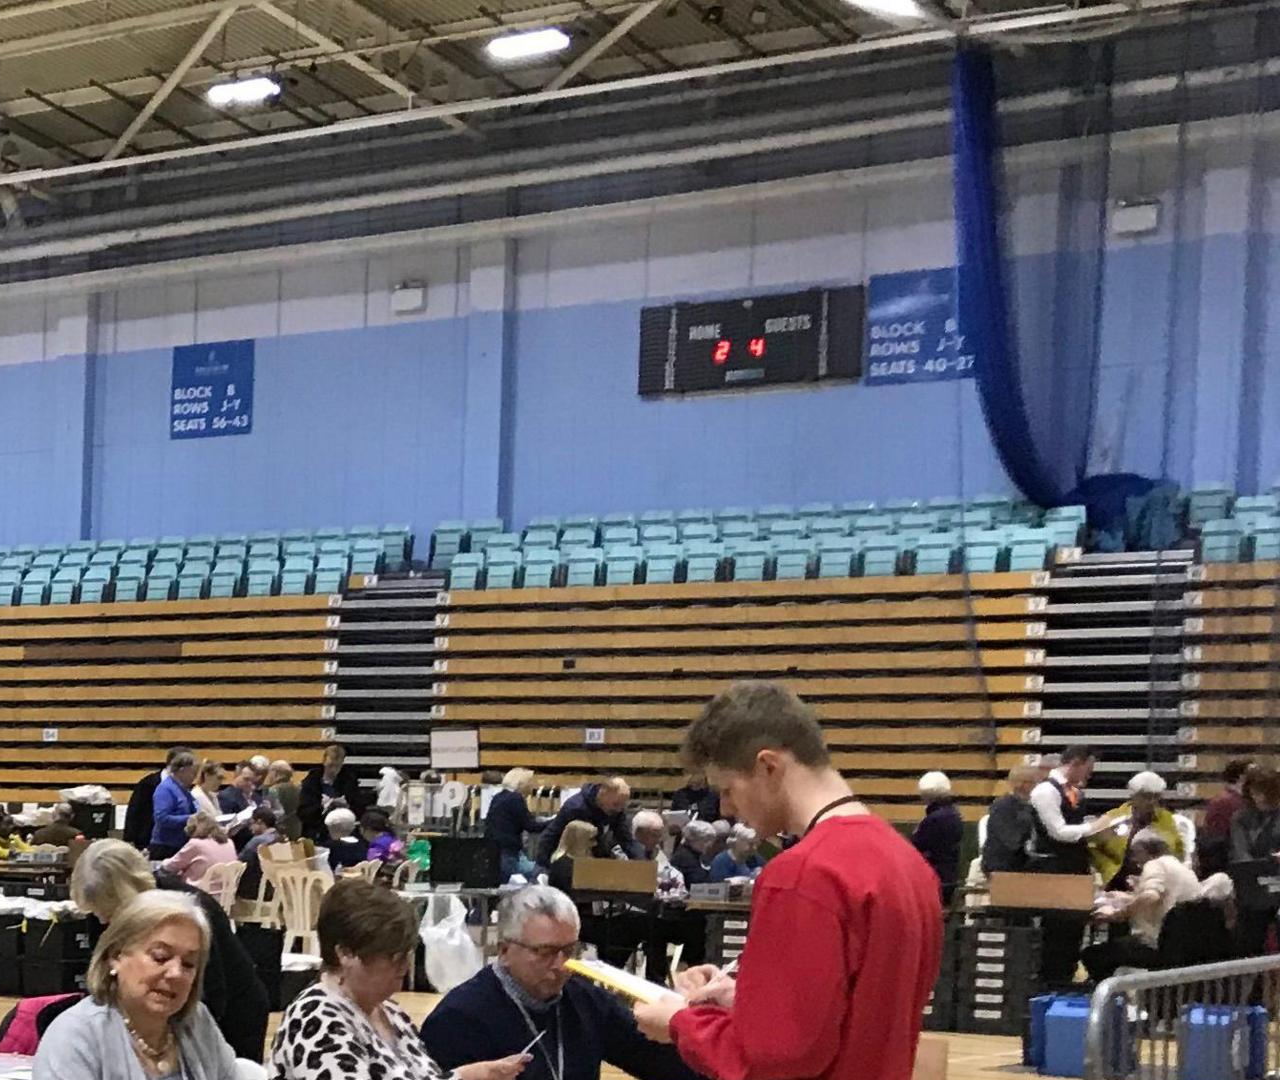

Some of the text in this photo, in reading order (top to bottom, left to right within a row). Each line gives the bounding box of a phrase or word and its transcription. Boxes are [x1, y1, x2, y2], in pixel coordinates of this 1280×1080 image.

[689, 323, 721, 340] HOME
[871, 321, 925, 339] BLOCK
[713, 337, 765, 362] 2 4
[870, 340, 920, 357] ROWS
[870, 360, 915, 376] SEATS
[174, 385, 212, 400] BLOCK
[173, 401, 209, 415] ROWS
[173, 418, 206, 432] SEATS
